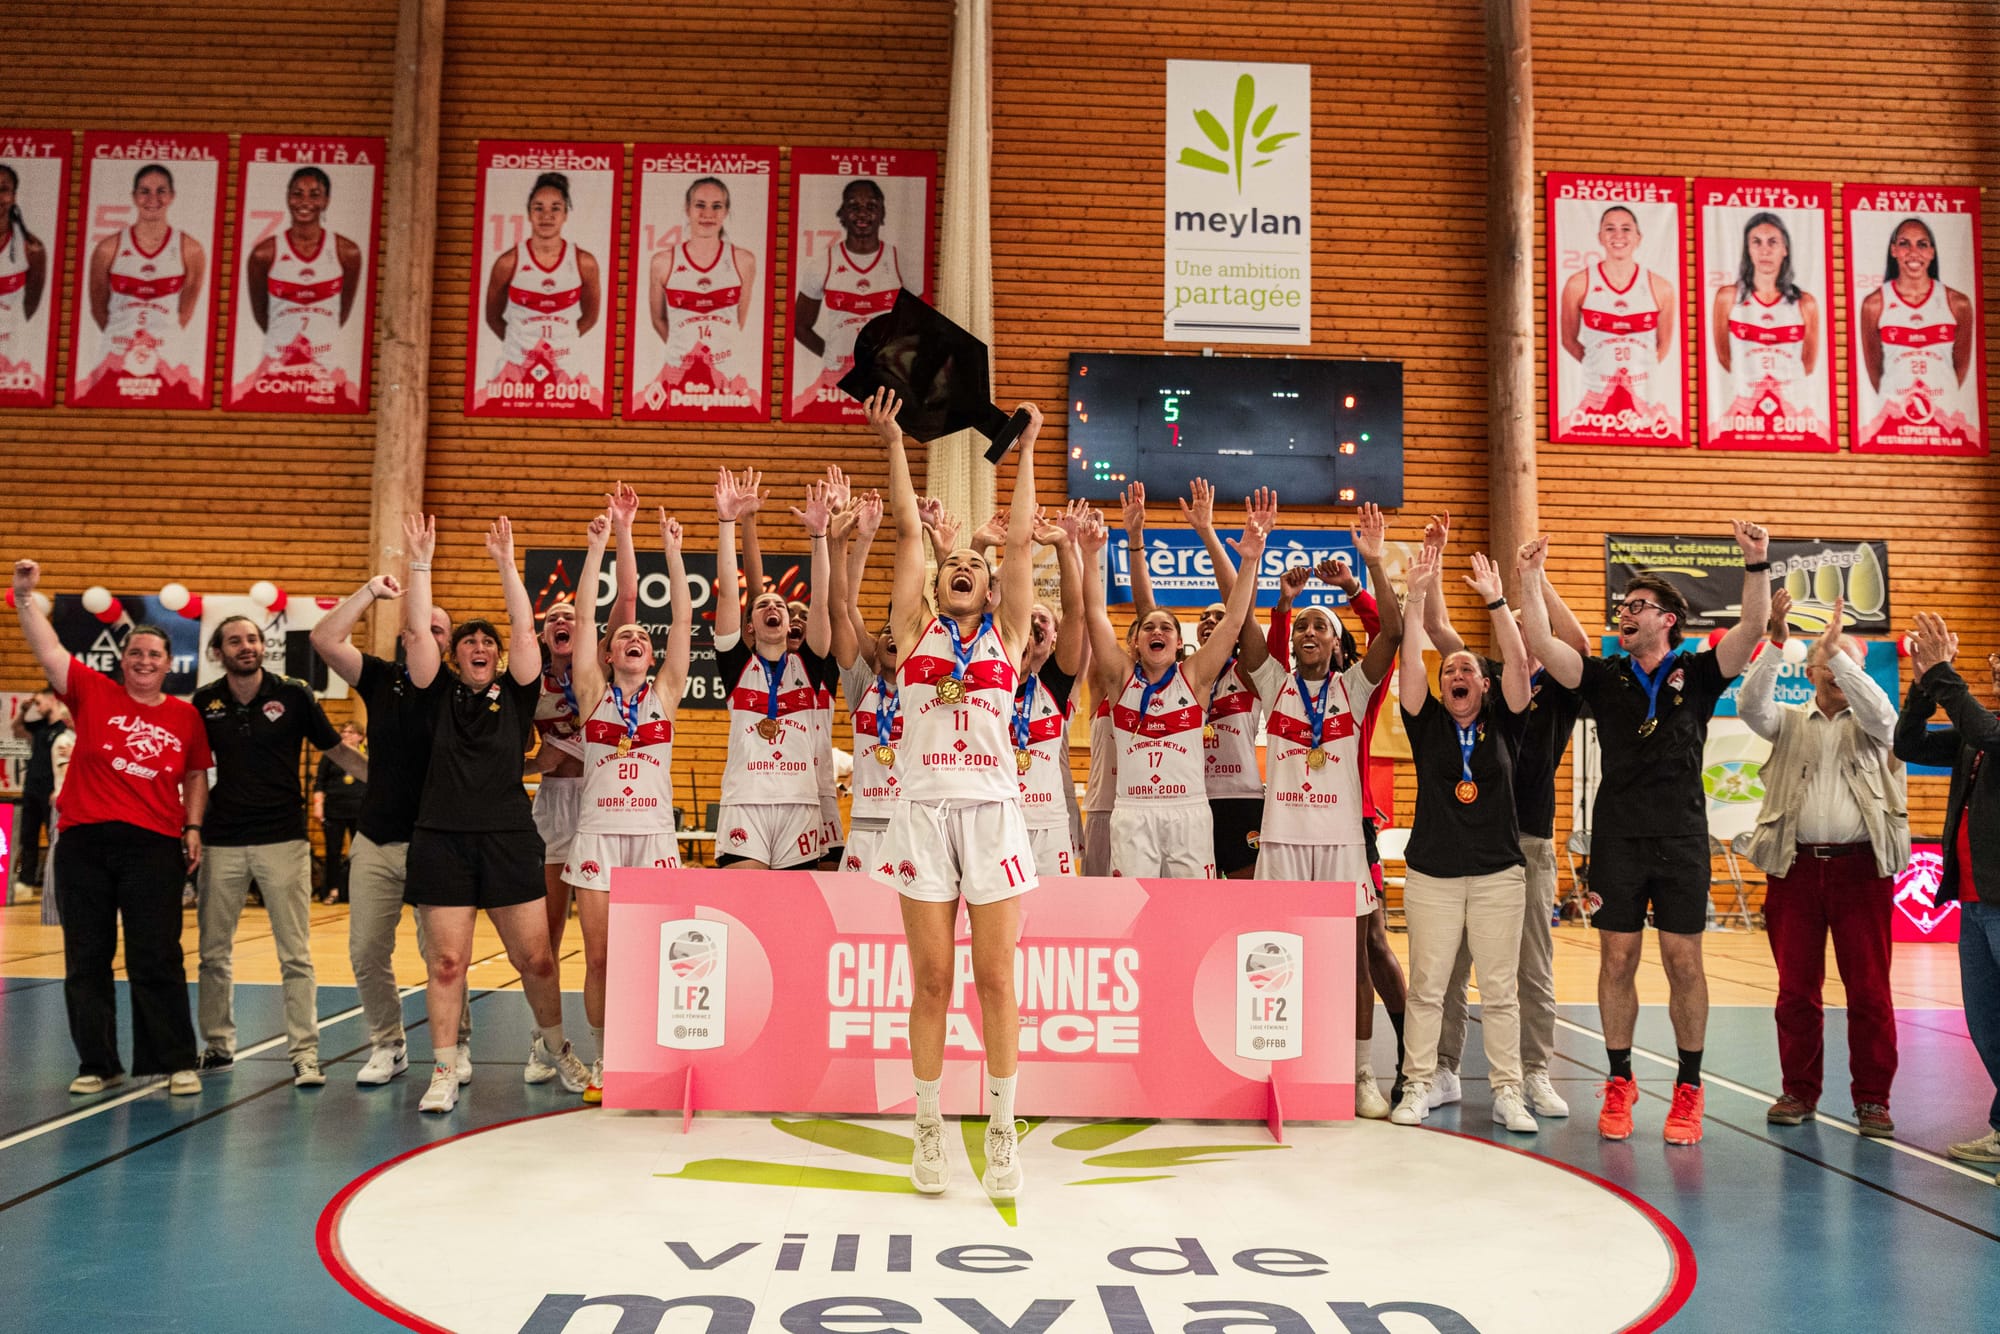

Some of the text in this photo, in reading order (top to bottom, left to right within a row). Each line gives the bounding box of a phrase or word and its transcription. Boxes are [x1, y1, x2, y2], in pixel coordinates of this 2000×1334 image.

[95, 144, 216, 160] CARDENAL
[254, 148, 370, 165] ELMIRA
[831, 155, 897, 163] MARLENE
[491, 154, 610, 170] BOISSERON
[642, 158, 770, 174] DESCHAMPS
[838, 162, 889, 176] BLE
[1560, 185, 1672, 203] DROGUET
[1708, 192, 1818, 209] PAUTOU
[1857, 197, 1965, 213] ARMANT
[1175, 207, 1301, 238] meylan
[490, 213, 524, 251] 11
[645, 224, 682, 251] 14
[803, 230, 842, 257] 17
[1175, 260, 1300, 280] Une ambition
[1174, 284, 1301, 312] partagée
[1164, 397, 1179, 422] 5
[1118, 539, 1216, 575] ière
[920, 703, 930, 714] LA
[971, 697, 1000, 718] MEYLAN
[953, 710, 968, 731] 11
[1133, 740, 1162, 751] TRONCHE
[1163, 741, 1187, 755] MEYLAN
[747, 762, 807, 771] WORK 2000
[923, 753, 956, 765] WORK
[1148, 752, 1163, 768] 17
[619, 763, 638, 779] 20
[1215, 764, 1242, 774] 2000
[863, 787, 890, 797] WORK
[1025, 792, 1052, 802] 2000
[1128, 784, 1186, 795] WORK 2000
[1276, 792, 1337, 803] WORK 2000
[597, 798, 657, 807] WORK 2000
[797, 829, 818, 856] 87
[1000, 854, 1025, 887] 11
[828, 942, 1139, 1012] CHAPNNES
[674, 986, 710, 1010] LF2
[1252, 997, 1287, 1022] LF2
[688, 1028, 708, 1037] FFBB
[1266, 1039, 1286, 1048] FFBB
[664, 1233, 1330, 1277] ville de
